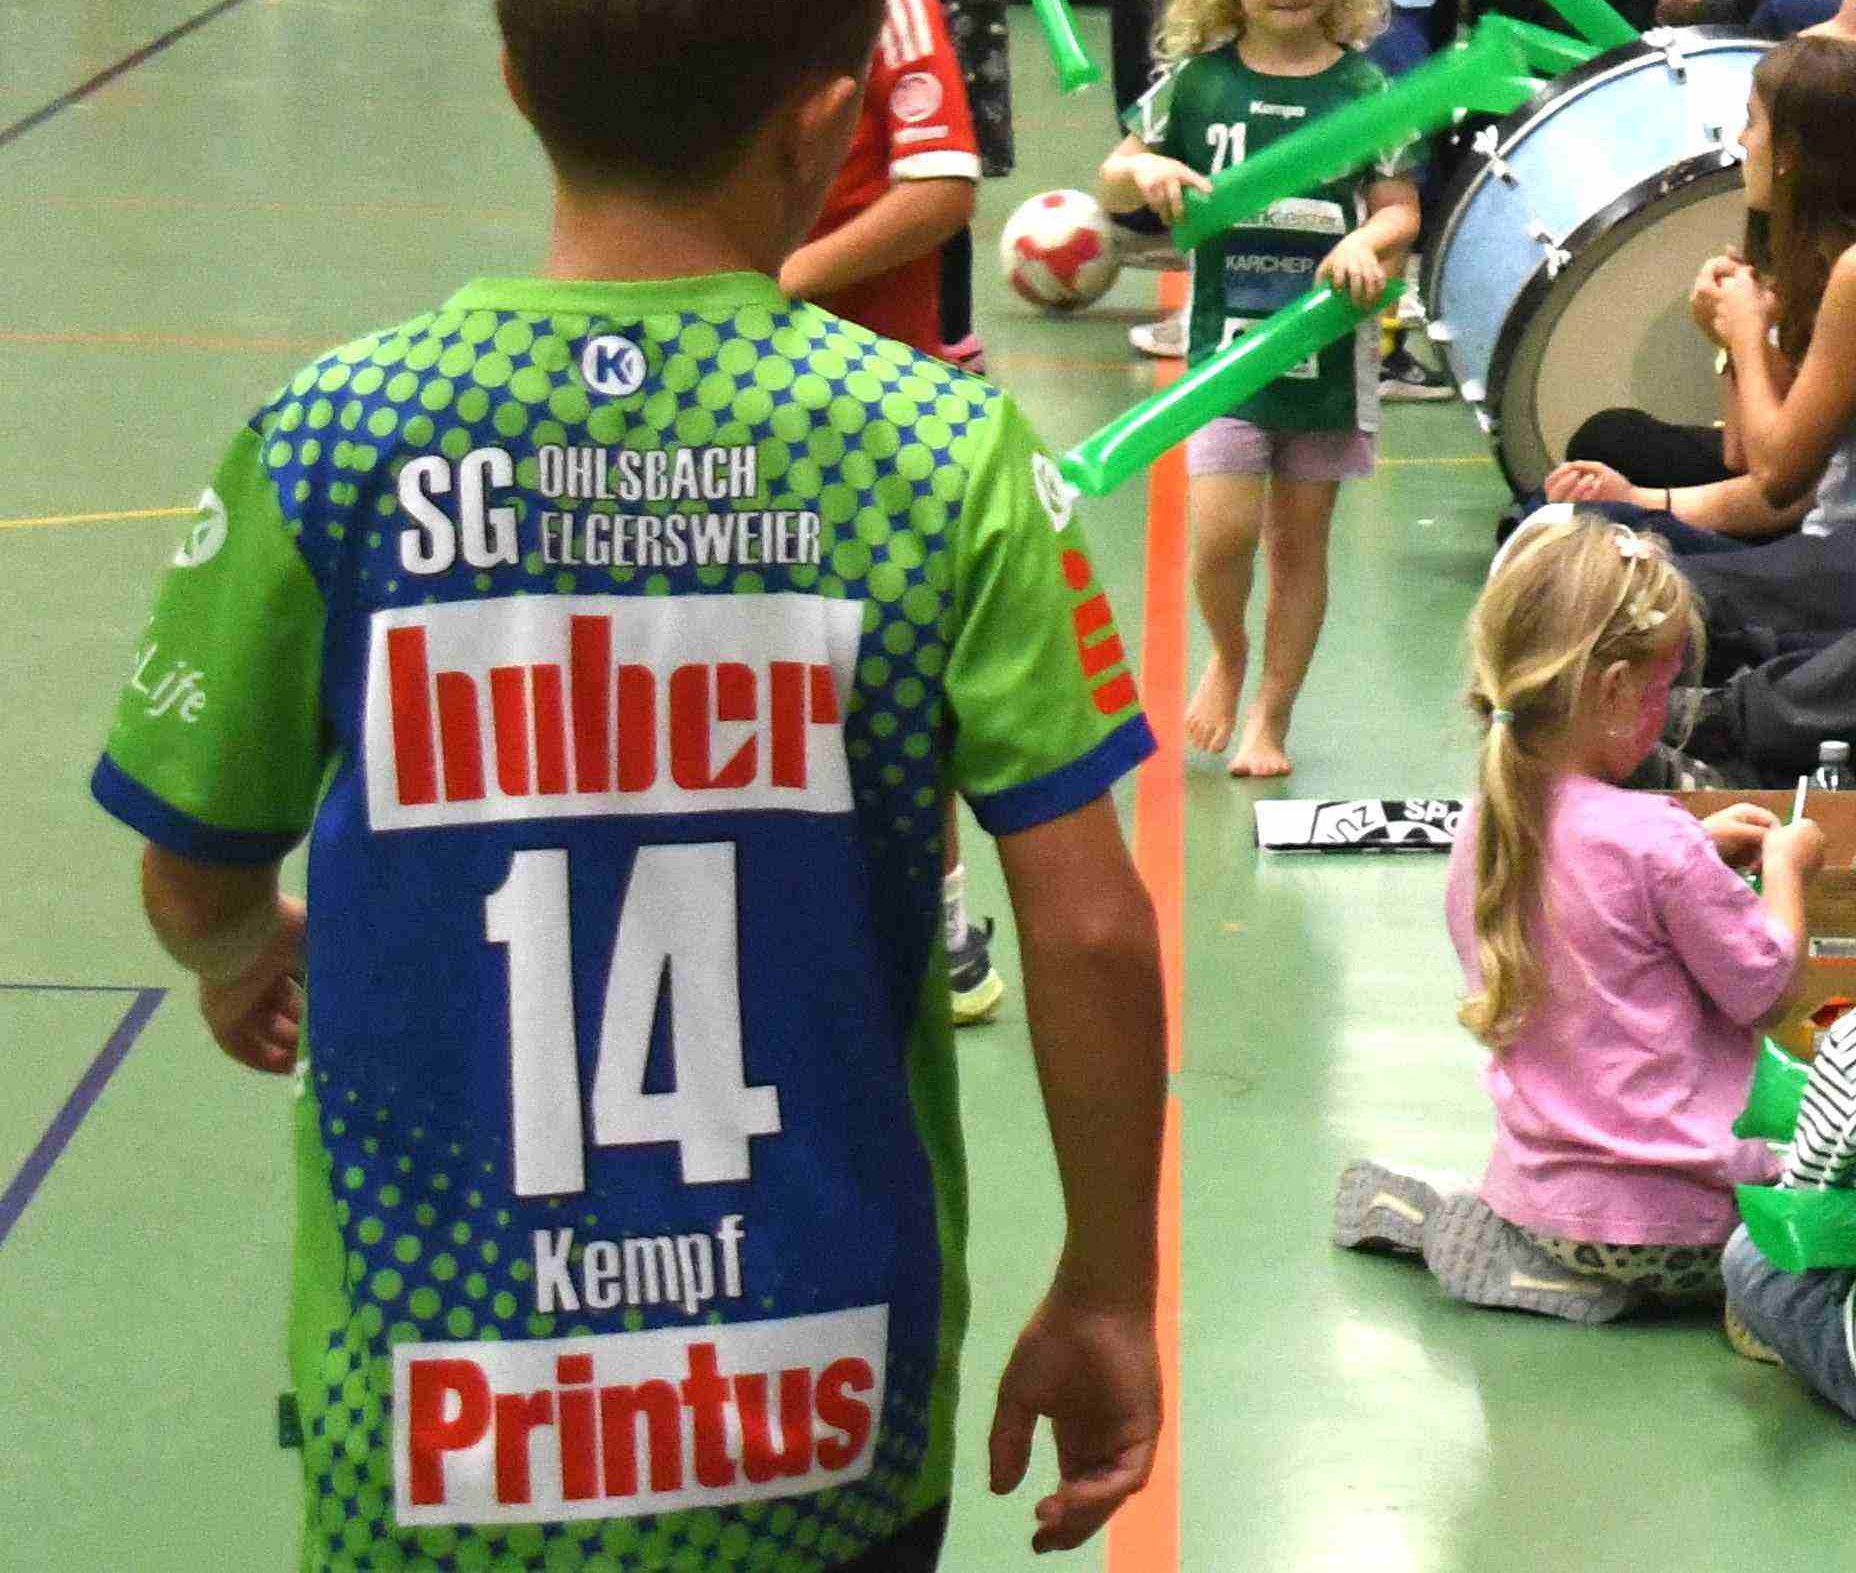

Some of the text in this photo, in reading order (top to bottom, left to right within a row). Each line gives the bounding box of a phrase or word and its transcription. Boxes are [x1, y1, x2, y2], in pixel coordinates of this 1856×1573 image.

[399, 444, 757, 575] SG OHLSBACH
[541, 511, 821, 567] ELGERSWEIER
[483, 840, 783, 1197] 14
[533, 1213, 747, 1316] Kempf
[407, 1340, 875, 1508] Printus
